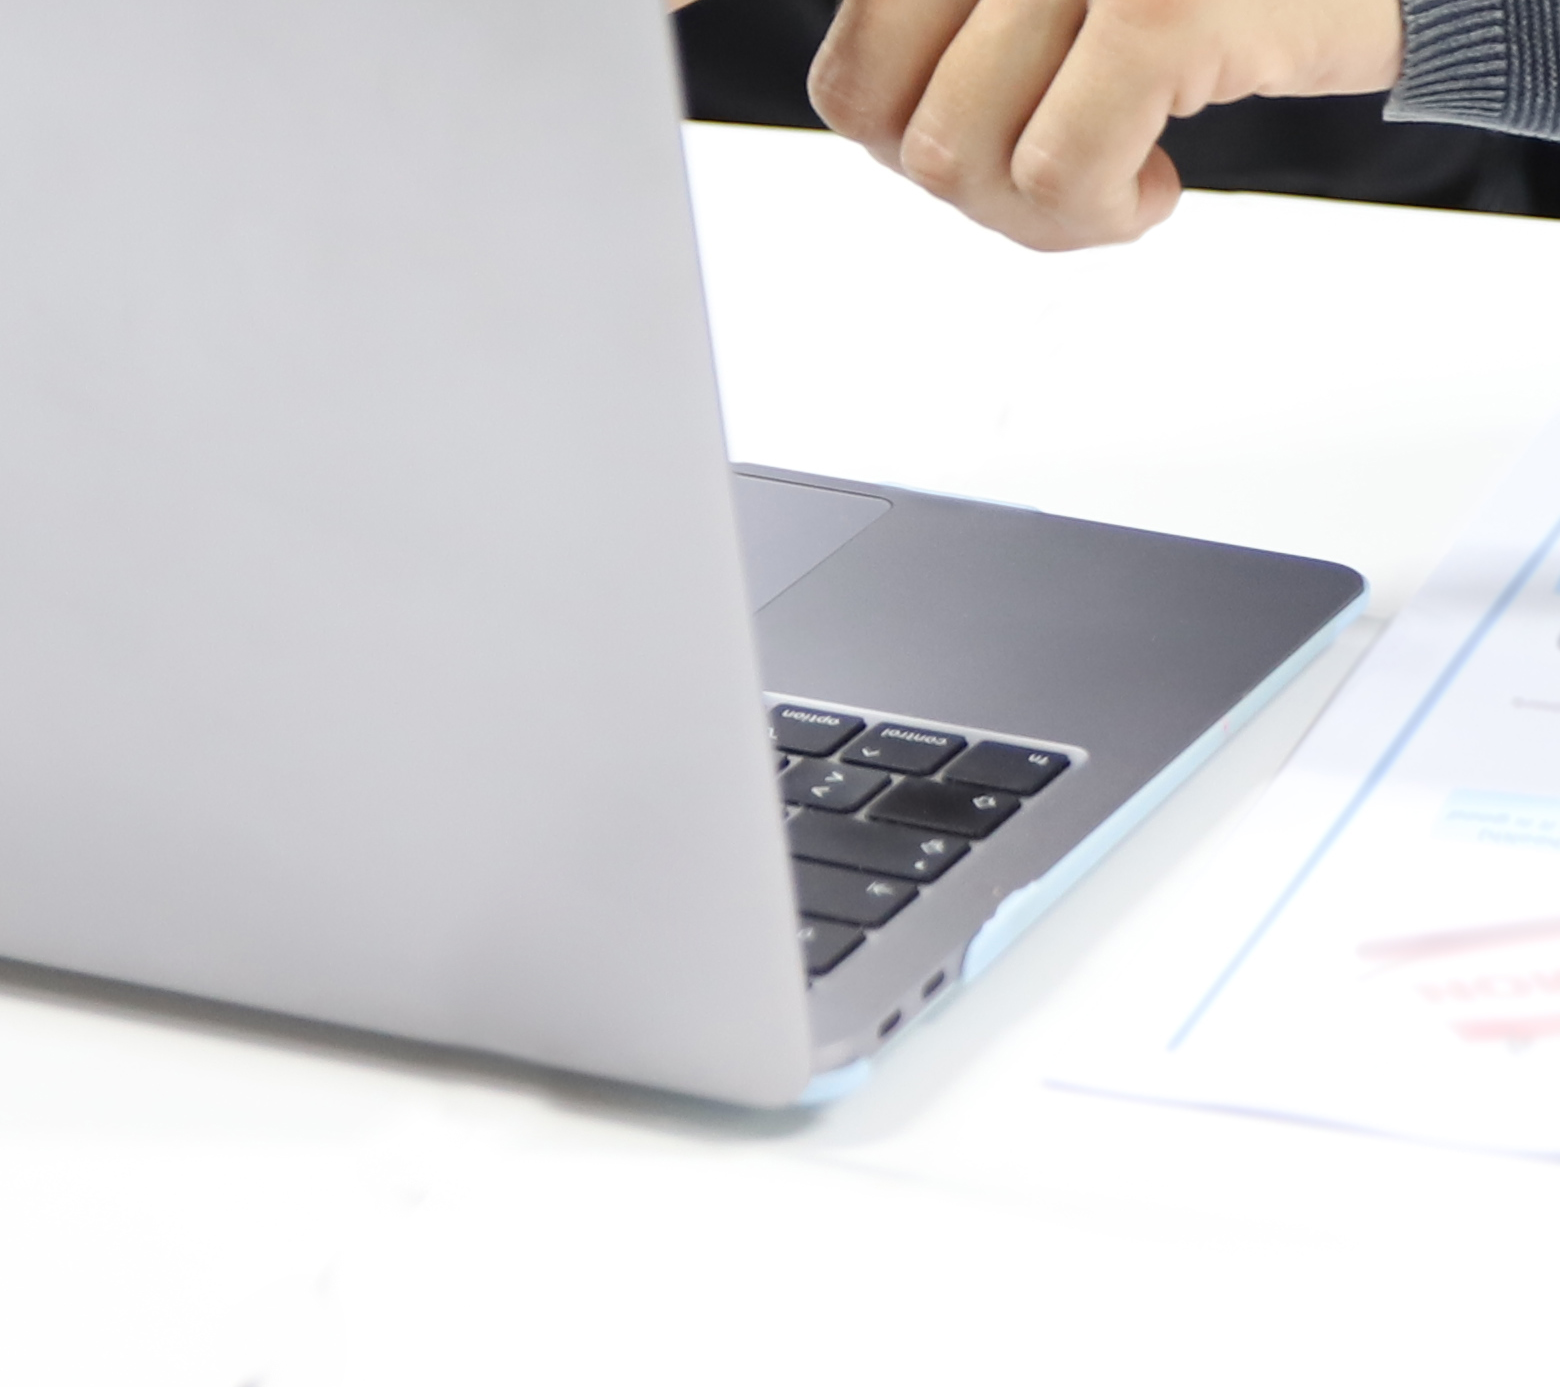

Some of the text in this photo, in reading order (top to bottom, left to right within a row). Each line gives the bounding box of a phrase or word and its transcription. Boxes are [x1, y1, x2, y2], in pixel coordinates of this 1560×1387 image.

[781, 708, 840, 726] option
[880, 727, 948, 747] control
[1028, 752, 1050, 767] fn
